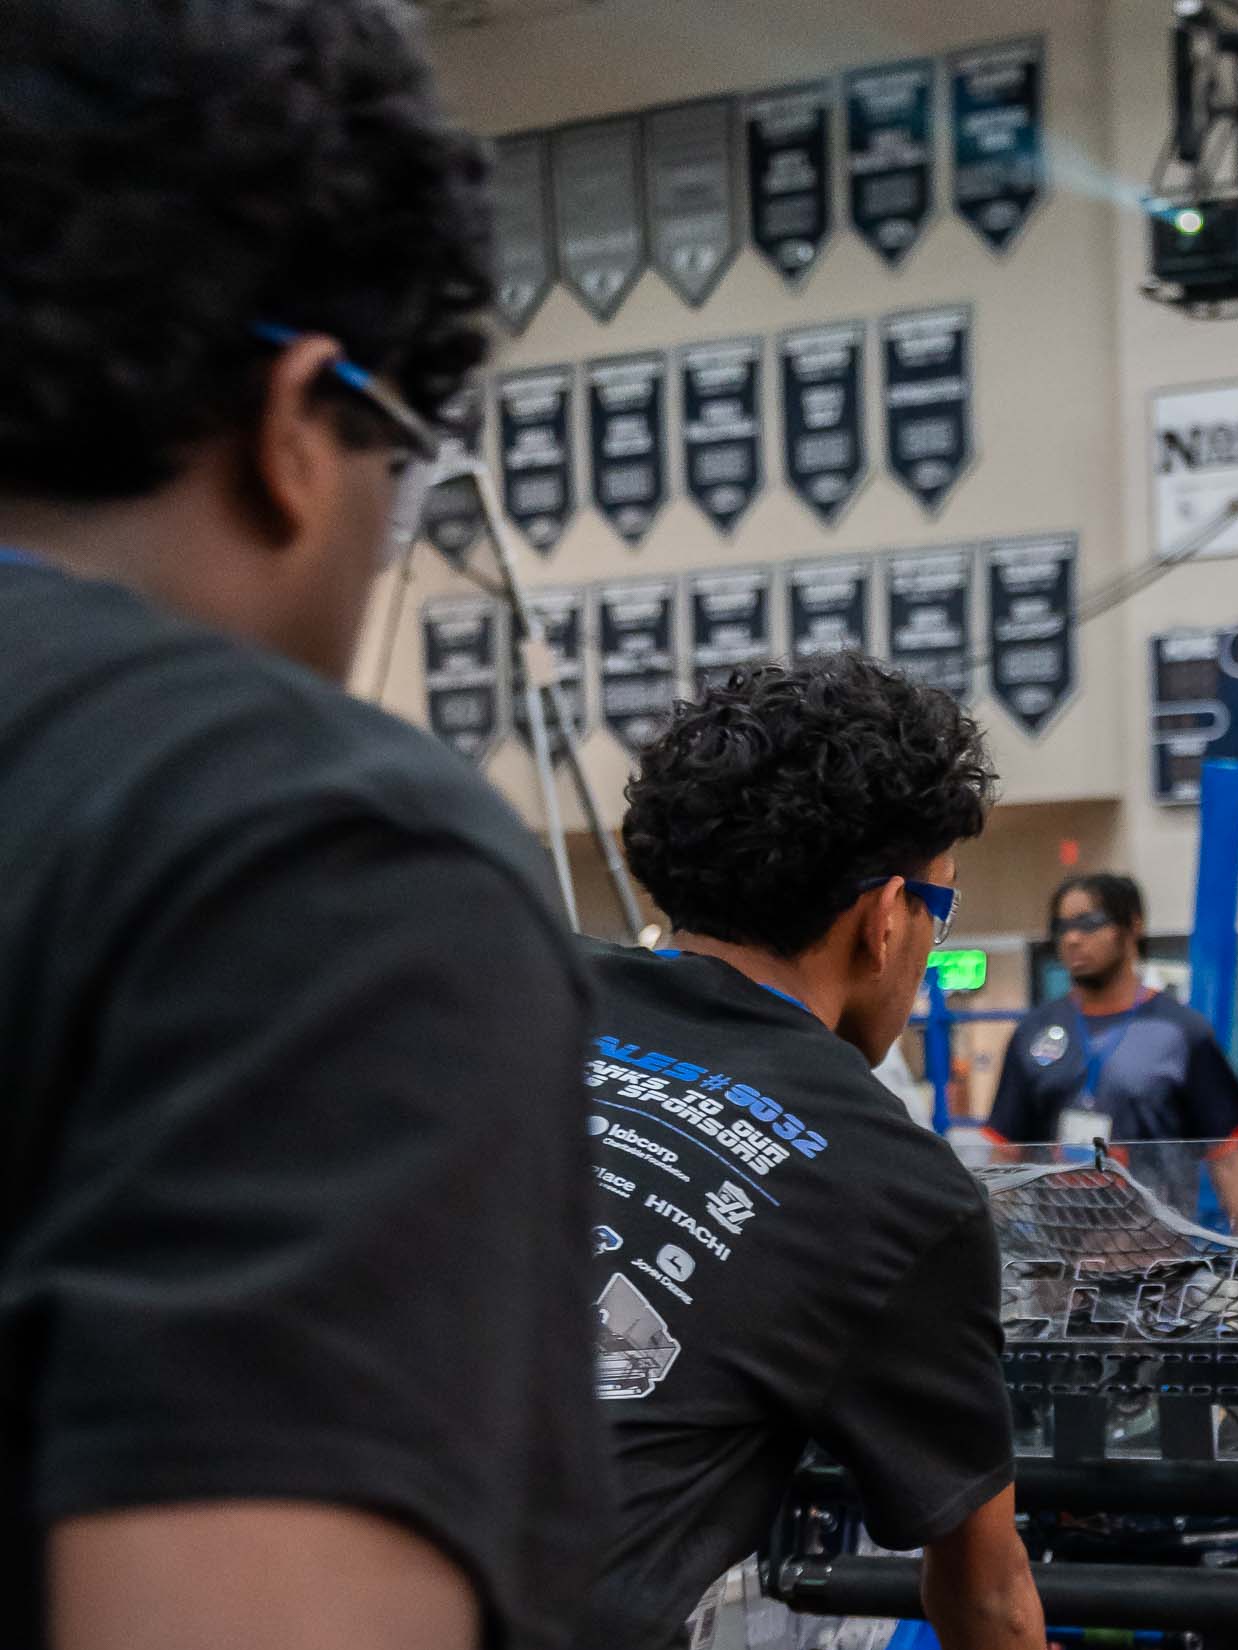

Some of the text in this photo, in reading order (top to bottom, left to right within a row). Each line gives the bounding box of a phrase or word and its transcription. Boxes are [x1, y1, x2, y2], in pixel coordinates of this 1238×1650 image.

[608, 1123, 679, 1163] labcorp
[616, 1084, 777, 1176] SPONSORS
[682, 1089, 724, 1115] TO
[731, 1119, 790, 1164] OUR
[643, 1194, 732, 1262] HITACHI
